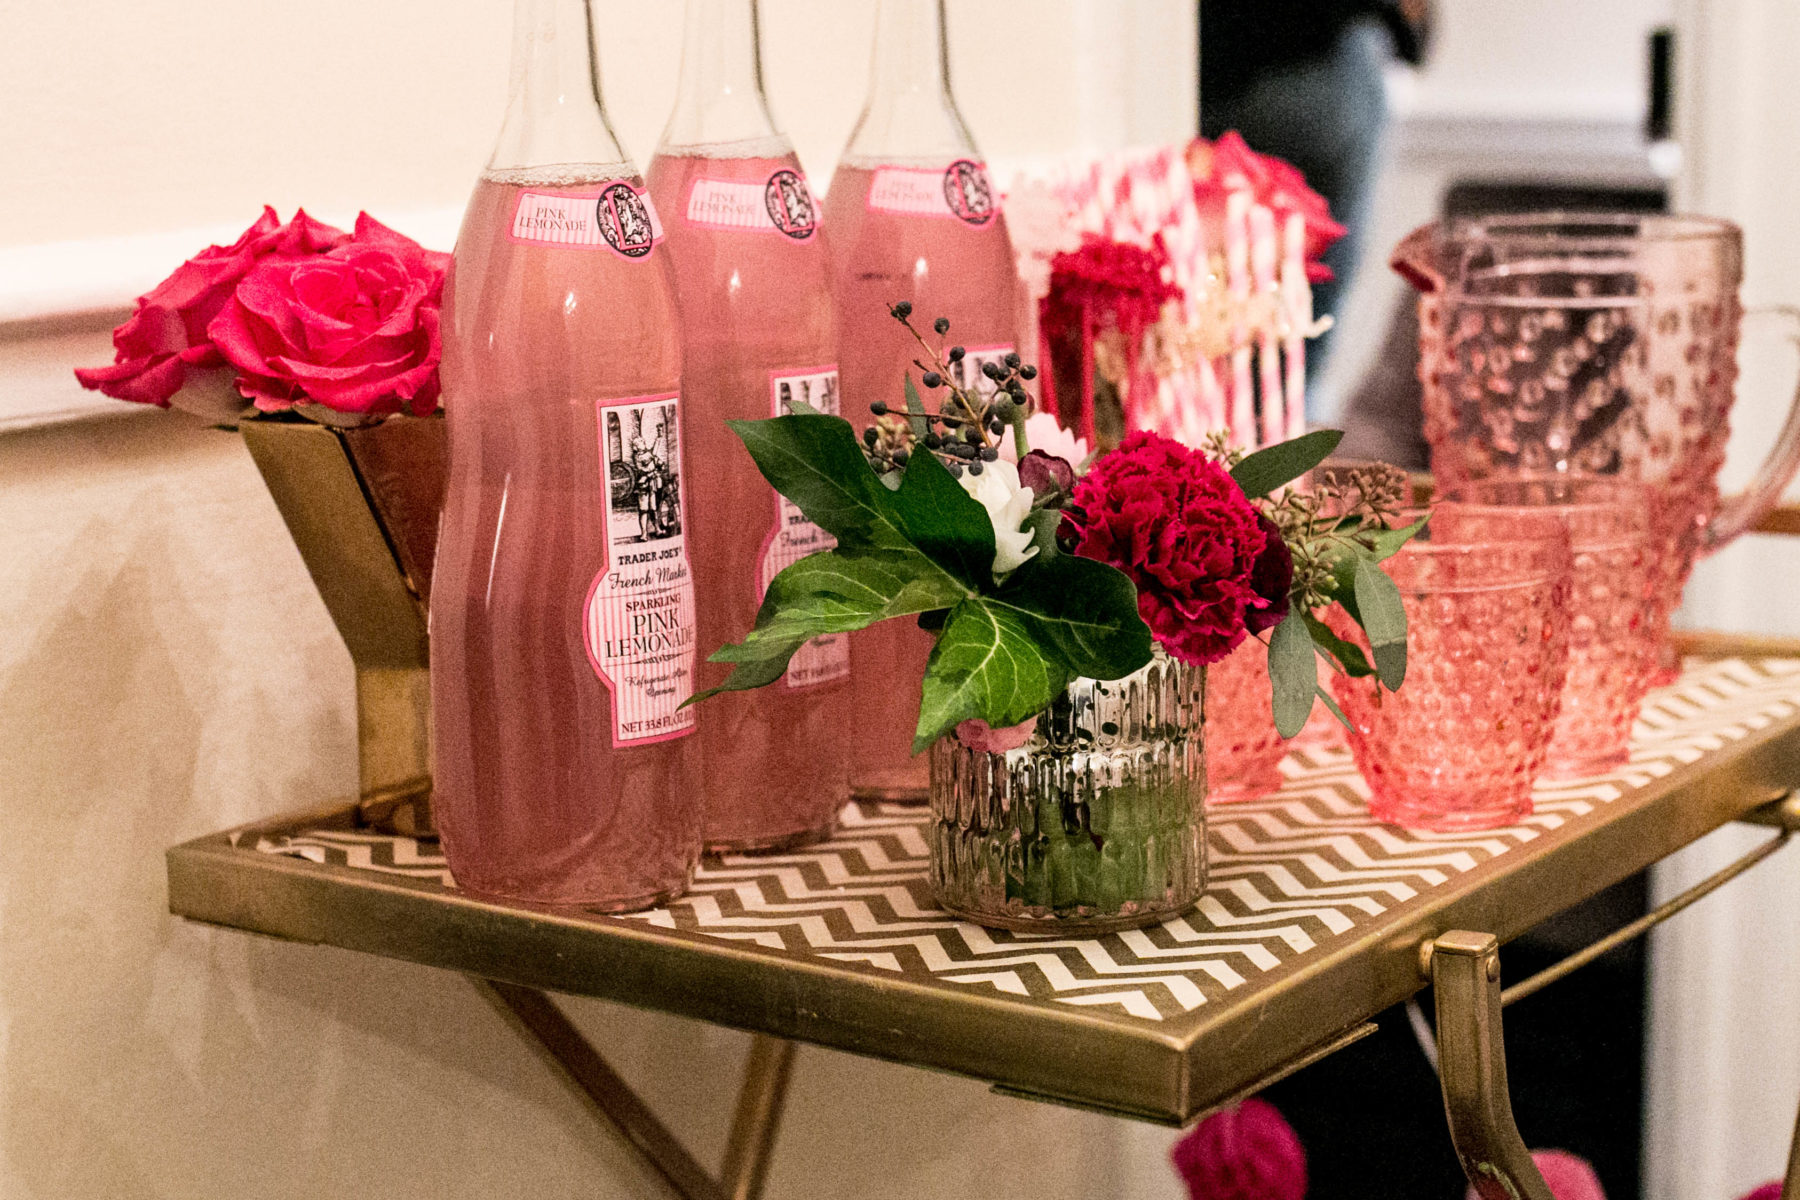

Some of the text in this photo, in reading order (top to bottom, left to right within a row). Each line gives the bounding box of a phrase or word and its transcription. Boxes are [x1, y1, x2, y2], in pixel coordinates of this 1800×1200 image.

[536, 207, 567, 219] PINK
[519, 216, 587, 231] LEMONADE
[618, 551, 657, 566] TRADER
[608, 569, 652, 589] French
[626, 593, 681, 612] SPARKLING
[633, 608, 679, 635] PINK
[605, 624, 694, 658] LEMONADE
[621, 721, 643, 734] NET
